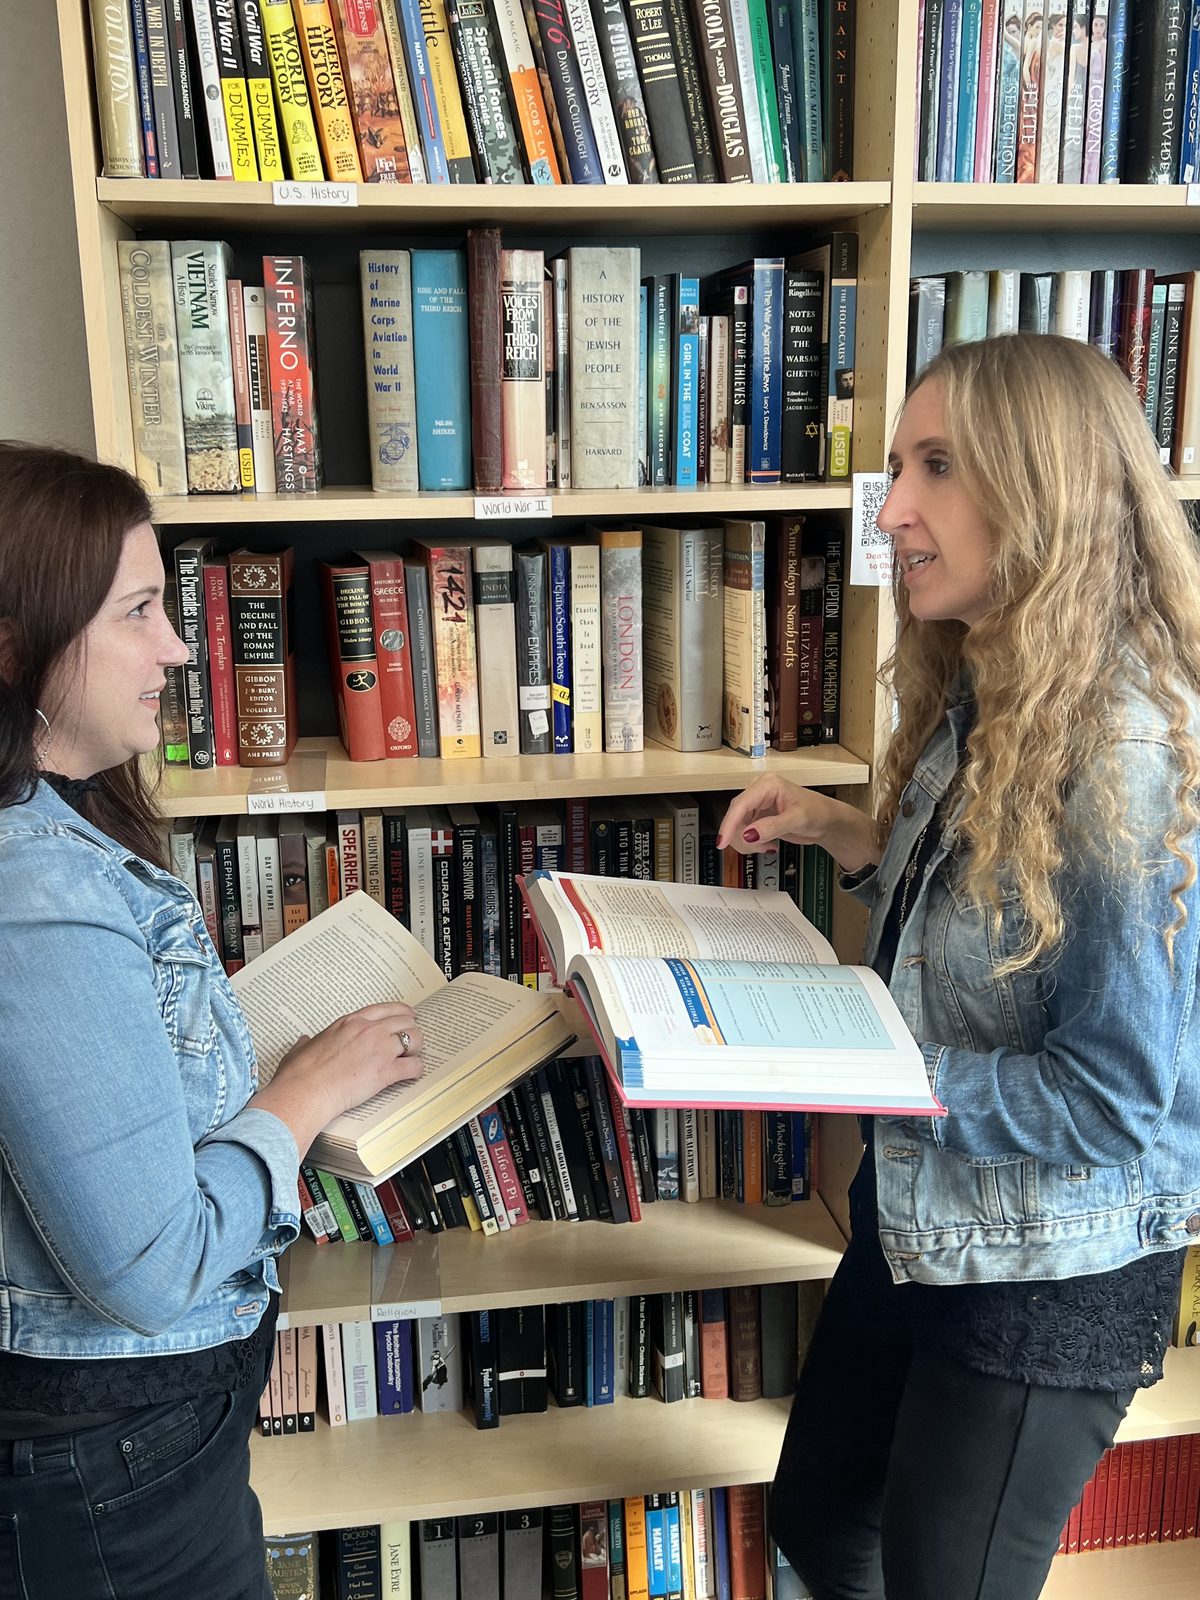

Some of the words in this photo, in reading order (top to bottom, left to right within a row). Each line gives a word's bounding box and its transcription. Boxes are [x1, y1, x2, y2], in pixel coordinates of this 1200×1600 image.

[635, 7, 663, 20] ROBERT
[198, 10, 214, 68] AMERICA
[217, 23, 235, 53] War
[249, 36, 264, 65] War
[607, 23, 634, 81] FORGE
[151, 51, 168, 87] DEPTH
[269, 34, 294, 105] HISTORY
[281, 26, 309, 108] WORLD
[306, 26, 336, 110] HISTORY
[321, 24, 347, 107] AMERICAN
[414, 42, 425, 74] NATION
[556, 51, 570, 84] DAVID
[644, 53, 672, 62] THOMAS
[465, 27, 483, 93] Recognition
[479, 94, 490, 126] Guide
[475, 26, 499, 84] Special
[488, 87, 507, 139] Forces
[578, 41, 600, 107] HISTORY
[808, 46, 817, 99] AMERICAN
[1163, 48, 1177, 102] FATES
[229, 92, 251, 168] DUMMIES
[256, 92, 277, 168] DUMMIES
[716, 83, 744, 158] DOUGLAS
[809, 103, 819, 155] MARRIAGE
[1001, 84, 1017, 176] SELECTION
[1022, 88, 1039, 145] ELITE
[1088, 82, 1103, 153] CROWN
[1104, 130, 1118, 175] MARK
[280, 187, 304, 200] U.S.
[311, 186, 350, 203] History
[367, 262, 400, 275] History
[130, 250, 155, 344] COLDEST
[186, 250, 210, 329] VIETNAM
[370, 297, 401, 308] Marine
[503, 295, 538, 309] VOICES
[582, 293, 625, 303] HISTORY
[274, 260, 298, 370] INFERNO
[371, 314, 396, 326] Corps
[506, 308, 535, 321] FROM
[511, 321, 531, 333] THE
[585, 317, 599, 327] OF
[603, 317, 621, 327] THE
[789, 310, 816, 318] NOTES
[928, 318, 938, 334] the
[372, 331, 408, 343] Aviation
[505, 333, 538, 347] THIRD
[735, 321, 746, 344] CITY
[762, 324, 773, 355] Against
[790, 325, 812, 333] FROM
[838, 302, 847, 366] HOLOCAUST
[506, 347, 537, 360] REICH
[586, 341, 620, 350] JEWISH
[792, 340, 810, 348] THE
[1149, 330, 1160, 376] WICKED
[373, 365, 399, 376] World
[585, 364, 621, 373] PEOPLE
[786, 370, 819, 378] GHETTO
[138, 345, 161, 426] WINTER
[375, 382, 393, 393] War
[734, 363, 746, 405] THIEVES
[1162, 359, 1177, 435] EXCHANGE
[195, 400, 216, 412] Viking
[295, 428, 306, 453] MAX
[585, 448, 622, 456] HARVARD
[682, 431, 690, 458] COAT
[834, 431, 846, 466] USED
[241, 452, 252, 482] USED
[281, 428, 295, 489] HASTINGS
[482, 502, 511, 516] World
[514, 503, 533, 514] War
[788, 525, 800, 556] Anne
[827, 541, 841, 556] THE
[179, 557, 198, 574] The
[866, 552, 889, 560] Don't
[210, 577, 218, 601] JONES
[340, 587, 365, 595] DECLINE
[374, 587, 404, 596] GREECE
[482, 583, 508, 591] INDIA
[785, 558, 799, 596] Boleyn
[181, 576, 199, 617] Crusades
[438, 566, 466, 624] 1421
[825, 584, 840, 618] OPTION
[240, 612, 276, 620] DECLINE
[340, 616, 370, 626] GIBBON
[785, 604, 797, 637] Norah
[243, 642, 275, 650] ROMAN
[556, 617, 566, 649] South
[617, 594, 635, 690] LONDON
[824, 632, 838, 657] MILES
[217, 635, 226, 671] Templars
[527, 637, 541, 685] EMPIRES
[556, 651, 566, 680] Texas
[783, 640, 796, 667] Lofts
[800, 622, 810, 694] ELIZABETH
[187, 670, 202, 697] Jonathan
[251, 799, 275, 810] World
[279, 798, 315, 810] History
[572, 806, 584, 843] MODERN
[619, 827, 628, 847] INTO
[368, 836, 380, 876] HUNTING
[462, 839, 473, 861] LONE
[620, 851, 628, 872] THIN
[223, 848, 234, 901] ELEPHANT
[440, 860, 450, 914] COURAGE
[462, 861, 474, 900] SURVIVOR
[266, 884, 275, 911] EMPIRE
[226, 904, 238, 954] COMPANY
[494, 1146, 507, 1171] Life
[685, 1141, 696, 1178] ALGERNON
[773, 1122, 787, 1180] Mockingbird
[476, 1144, 496, 1193] FAHRENHEIT
[511, 1139, 524, 1164] LORD
[522, 1180, 536, 1205] FLIES
[377, 1307, 417, 1319] Religion
[385, 1330, 393, 1351] Fyodor
[392, 1334, 400, 1357] Brothers
[386, 1351, 394, 1386] Dostoevsky
[393, 1358, 402, 1392] Karamazov
[481, 1367, 493, 1386] Fyodor
[342, 1530, 377, 1541] DICKENS
[434, 1525, 443, 1539] 1
[474, 1521, 485, 1535] 2
[520, 1515, 530, 1530] 3
[652, 1527, 663, 1571] HAMLET
[669, 1523, 680, 1564] HAMLET
[271, 1569, 306, 1577] AUSTEN
[391, 1567, 400, 1593] EYRE
